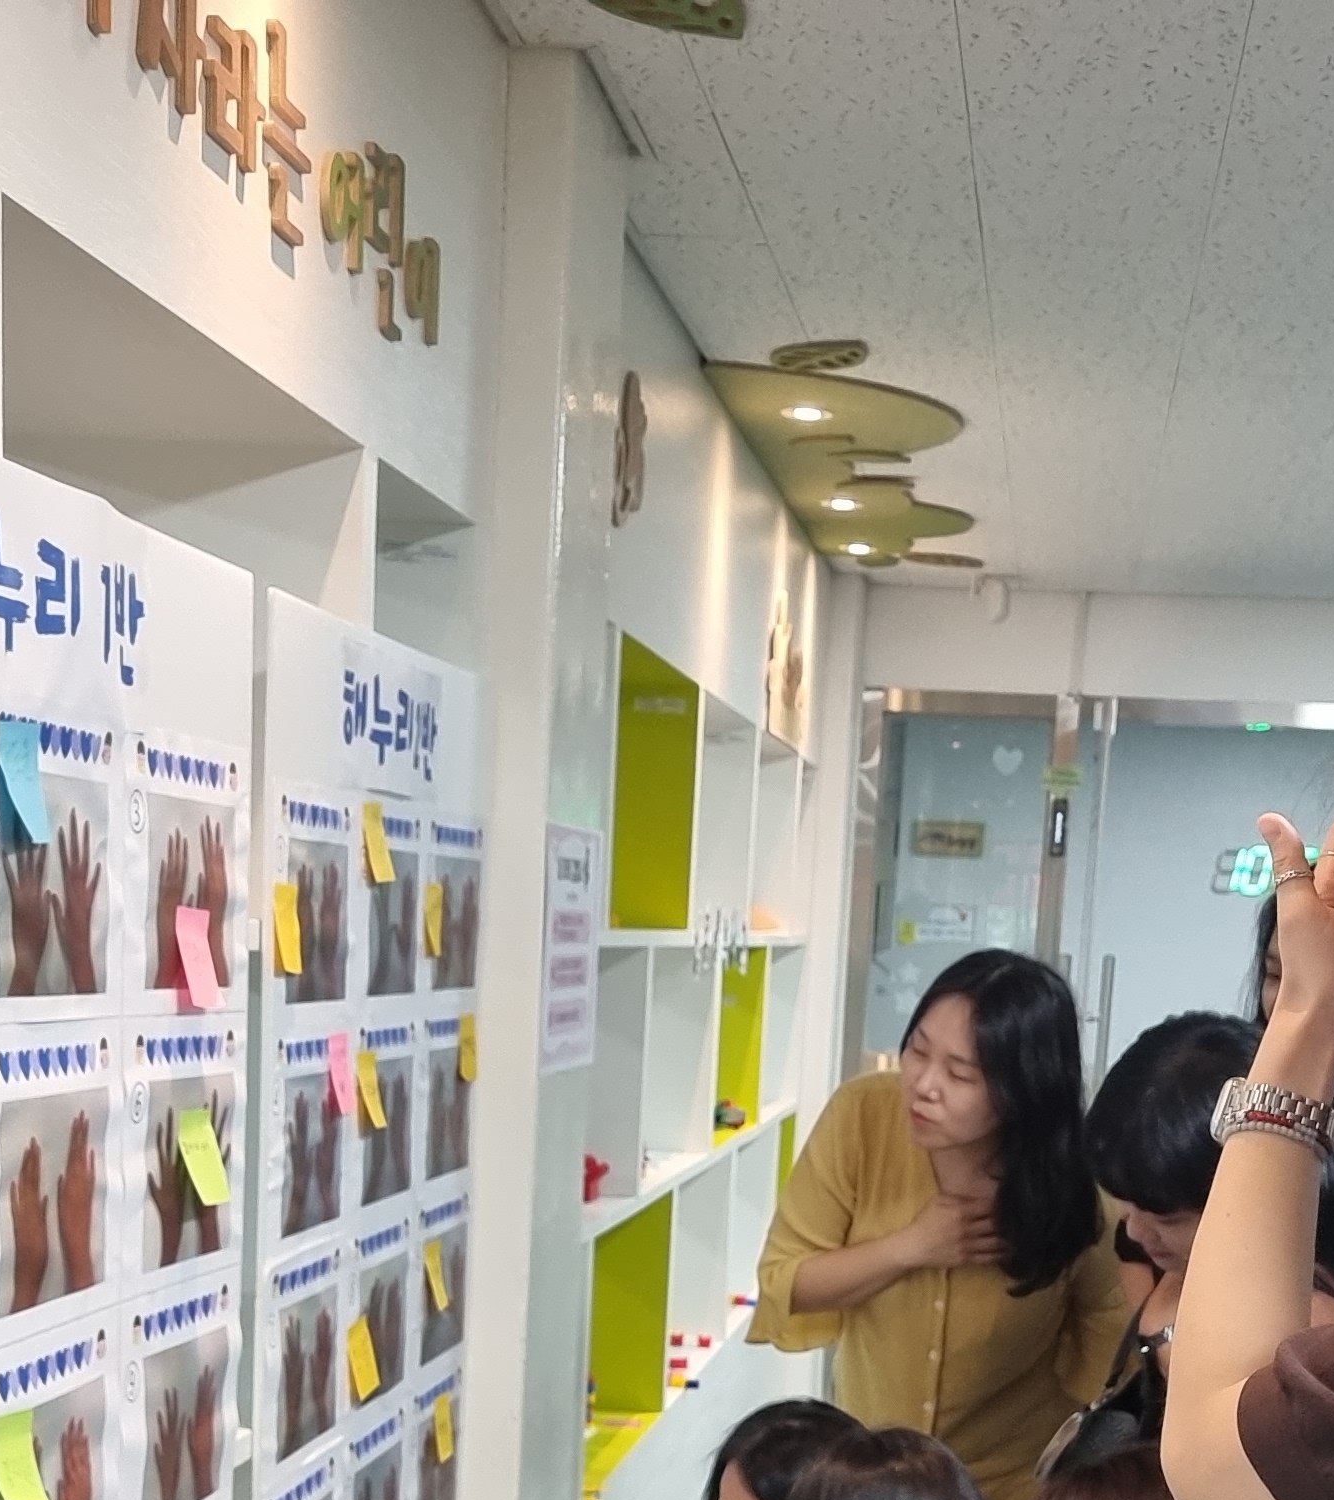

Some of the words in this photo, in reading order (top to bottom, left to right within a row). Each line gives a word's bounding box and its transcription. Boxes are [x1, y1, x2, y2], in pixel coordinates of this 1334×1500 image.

[320, 141, 441, 347] 어린이
[98, 561, 146, 687] 1반
[343, 669, 413, 767] 해누리
